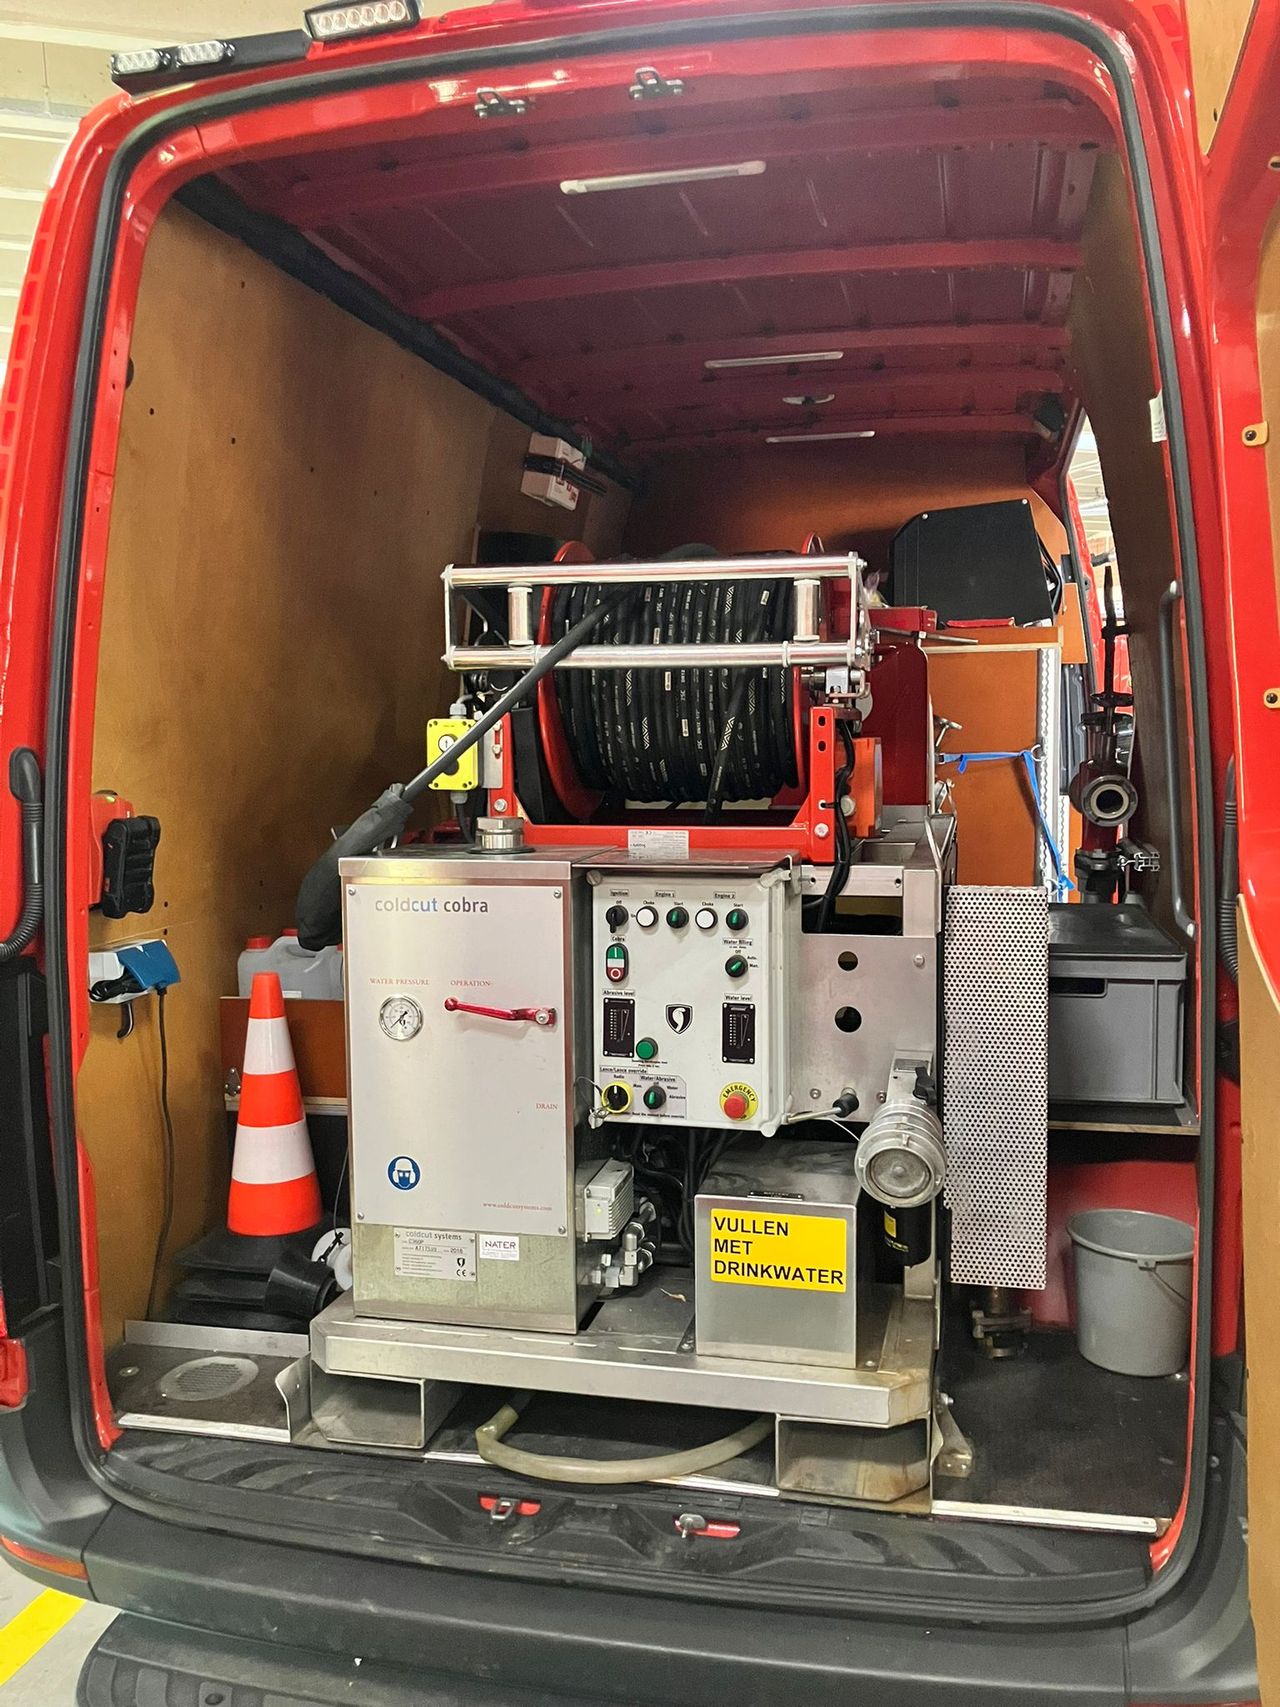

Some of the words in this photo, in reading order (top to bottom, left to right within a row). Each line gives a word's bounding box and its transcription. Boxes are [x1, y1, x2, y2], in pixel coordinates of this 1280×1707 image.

[375, 897, 438, 912] coldcut
[443, 897, 489, 913] cobra
[369, 977, 394, 985] WATER
[395, 978, 430, 986] PRESSURE
[450, 979, 491, 987] OPERATION
[722, 1084, 757, 1102] EMERGENCY
[535, 1102, 558, 1110] DRAIN
[713, 1216, 789, 1236] VULLEN
[405, 1231, 433, 1240] coldcut
[434, 1233, 462, 1242] systems
[484, 1240, 516, 1250] NATER
[714, 1238, 753, 1255] MET
[714, 1260, 844, 1285] DRINKWATER
